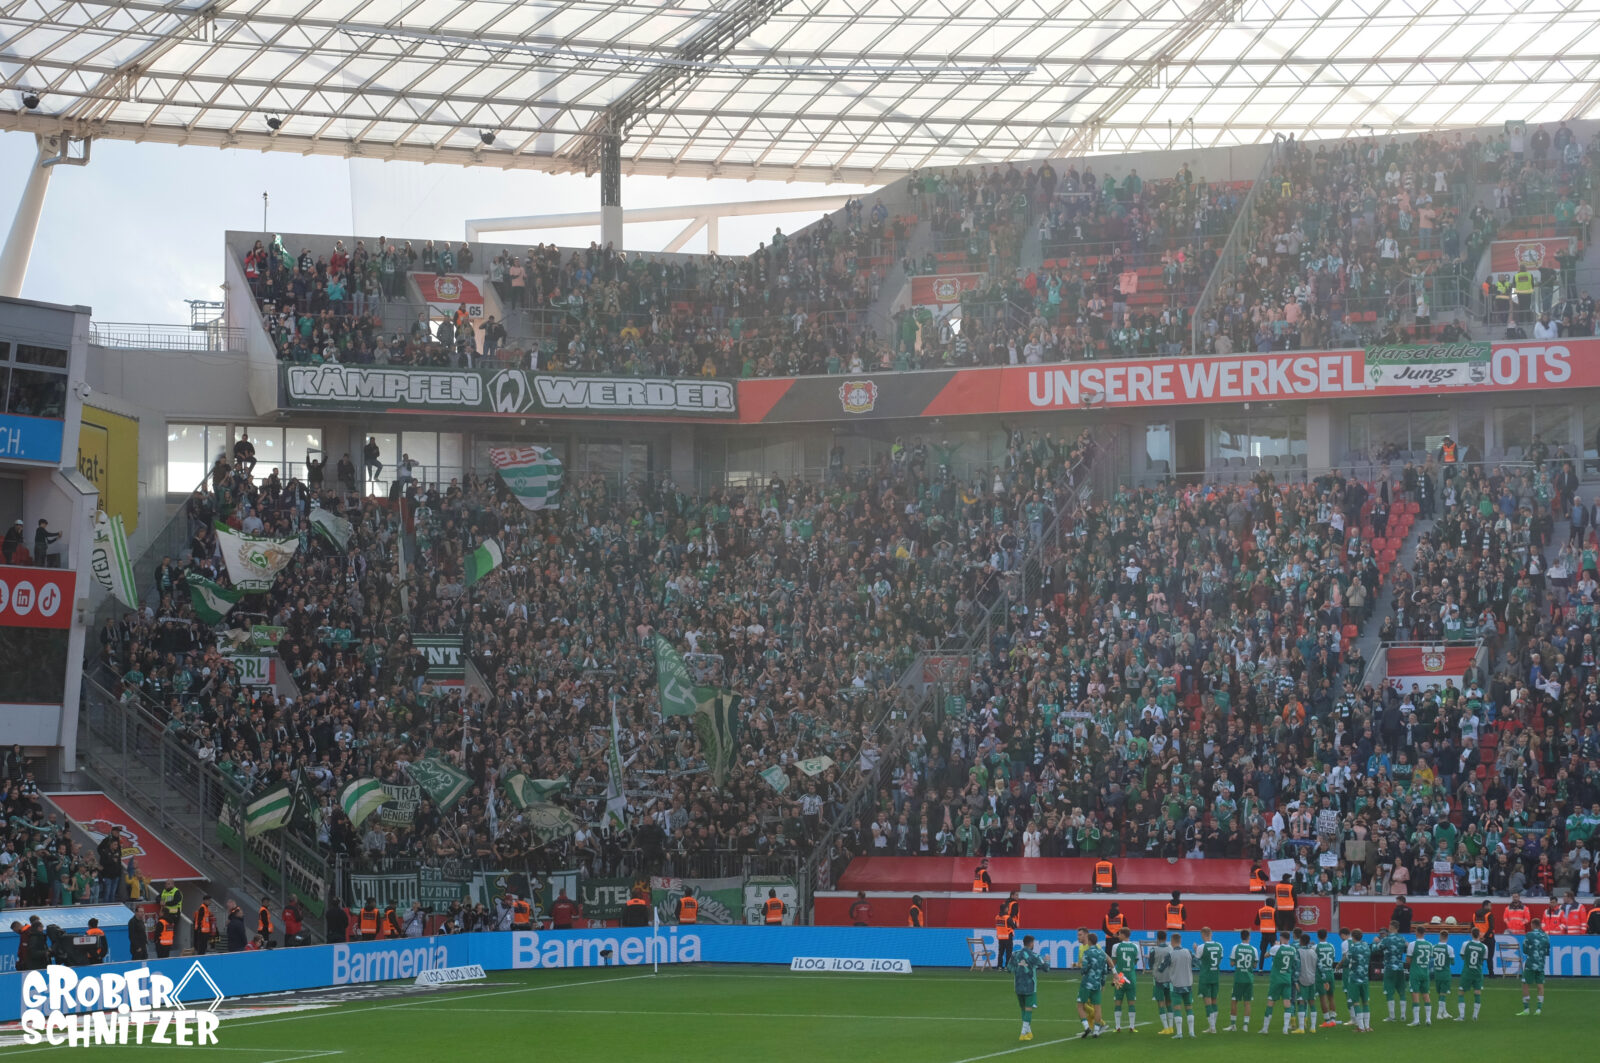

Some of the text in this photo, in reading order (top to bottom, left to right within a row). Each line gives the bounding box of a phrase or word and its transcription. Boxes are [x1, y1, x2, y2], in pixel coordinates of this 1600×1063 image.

[469, 306, 481, 316] G5
[1367, 343, 1489, 360] Harsefelder
[1028, 364, 1174, 406] UNSERE
[1179, 354, 1367, 398] WERKSEL
[1393, 365, 1457, 384] Jungs
[288, 364, 482, 406] KÄMPFEN
[534, 375, 736, 412] WERDER
[420, 887, 460, 897] AVANTI
[512, 926, 701, 969] Barmenia
[333, 936, 448, 985] Barmenia
[1122, 951, 1131, 967] 4
[1210, 951, 1218, 967] 5
[1236, 952, 1253, 968] 28
[1282, 955, 1291, 970] 9
[1319, 951, 1333, 966] 26
[1416, 949, 1430, 964] 23
[1470, 950, 1479, 965] 8
